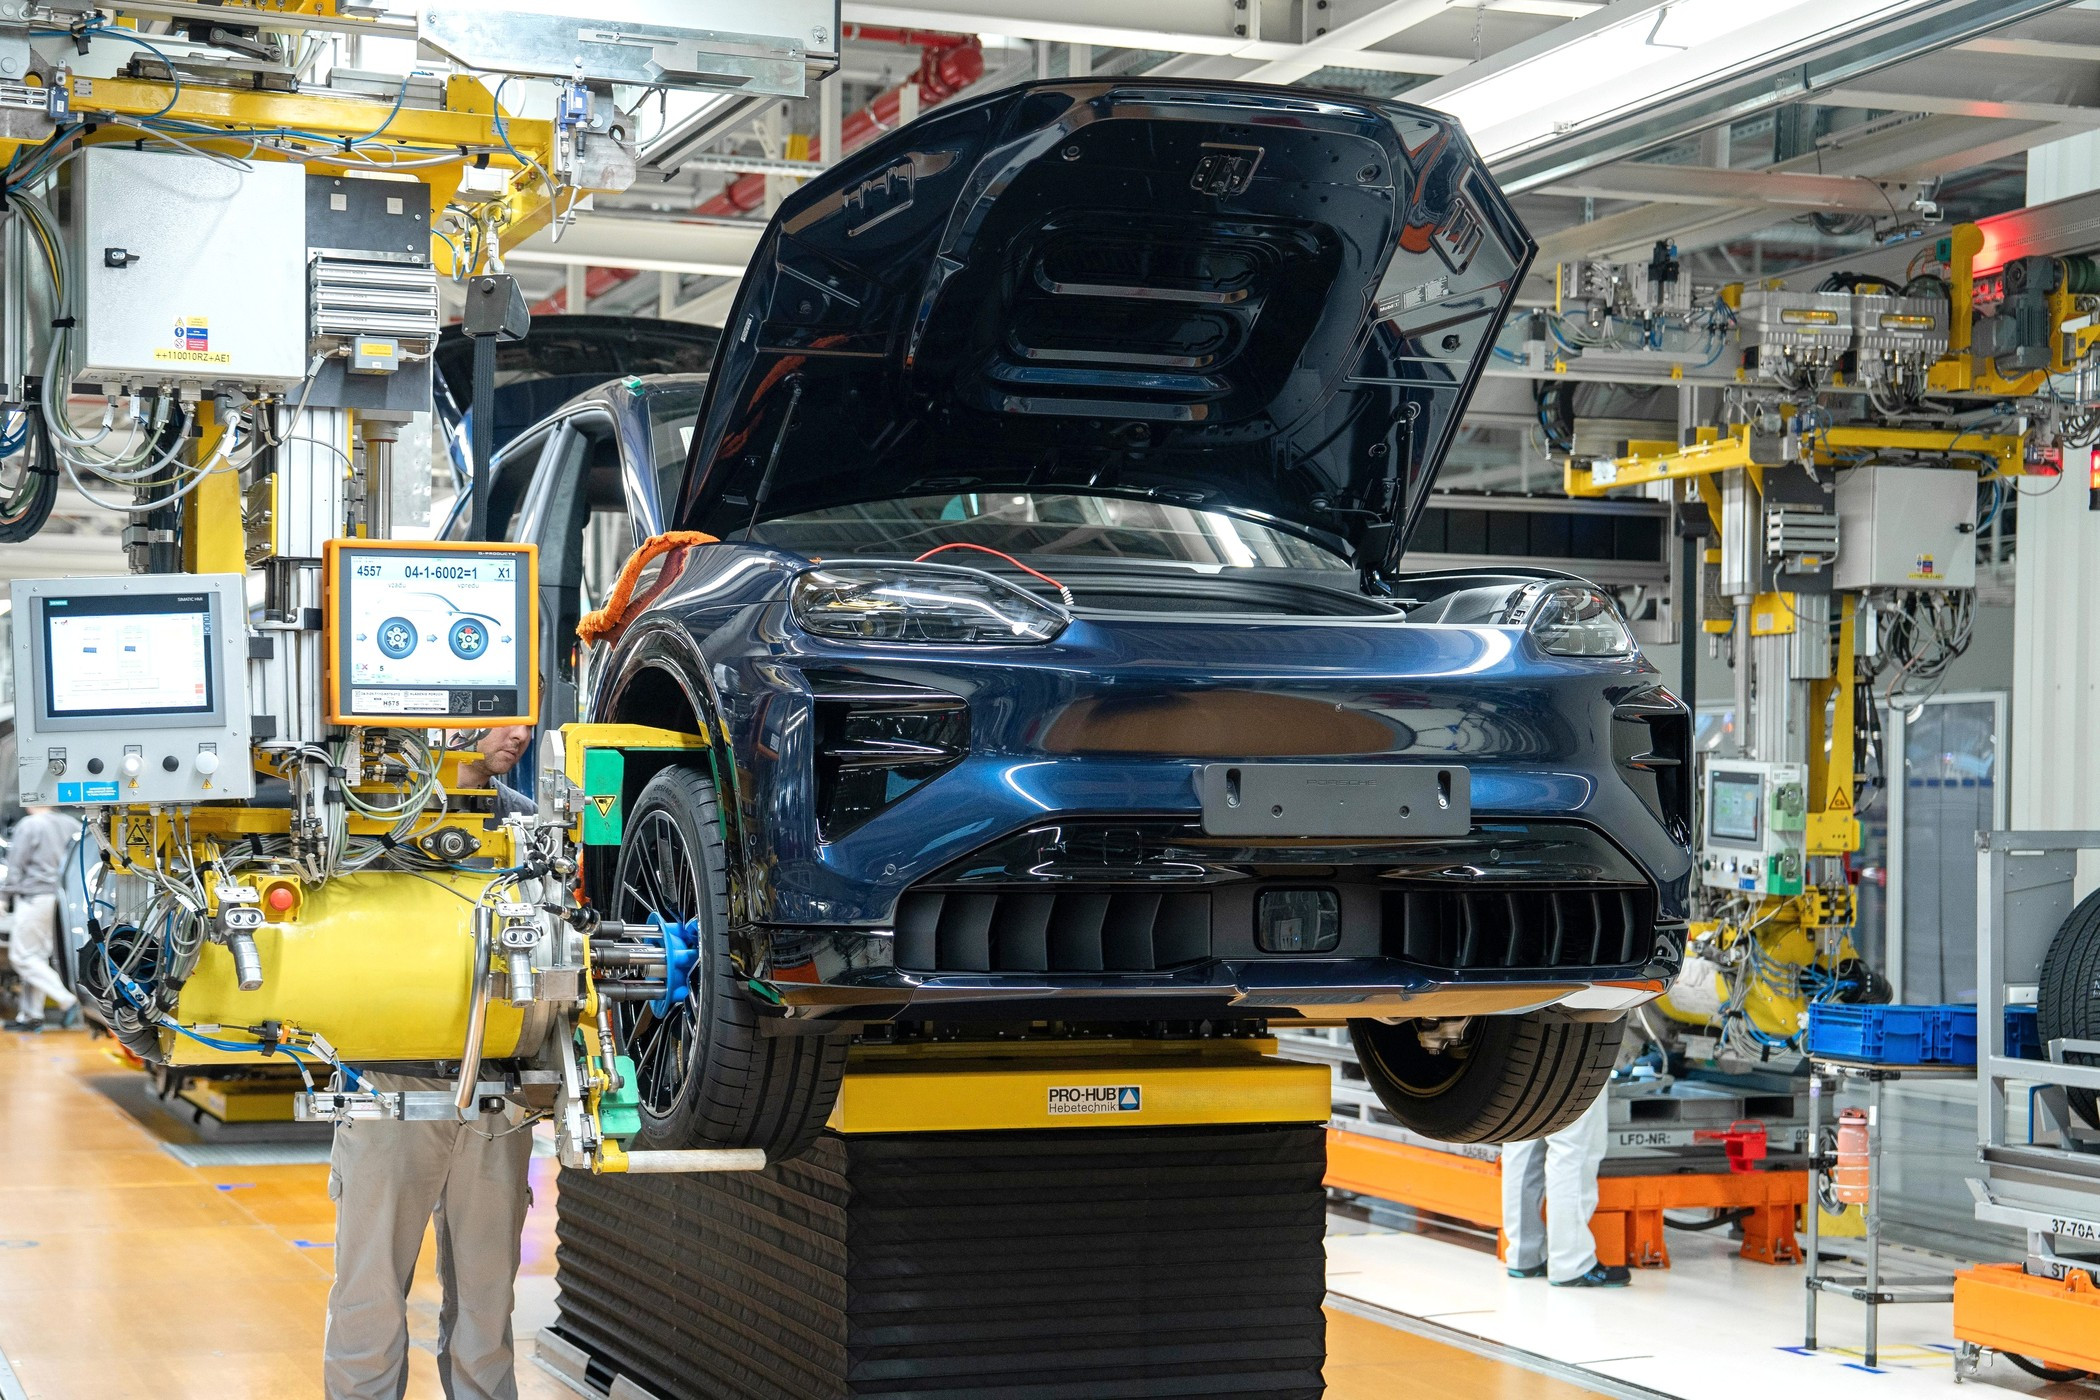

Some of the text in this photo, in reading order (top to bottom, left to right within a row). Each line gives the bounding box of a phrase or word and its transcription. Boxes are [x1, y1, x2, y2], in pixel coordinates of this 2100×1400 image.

[357, 565, 510, 580] 4557 04-1-6002=1 X1
[1306, 779, 1377, 787] PORSCHE
[1049, 1088, 1116, 1102] PRO-HUB
[1049, 1102, 1117, 1113] Hebetechnik
[1619, 1132, 1671, 1146] LFD-NR:
[2051, 1218, 2095, 1240] 37-70A
